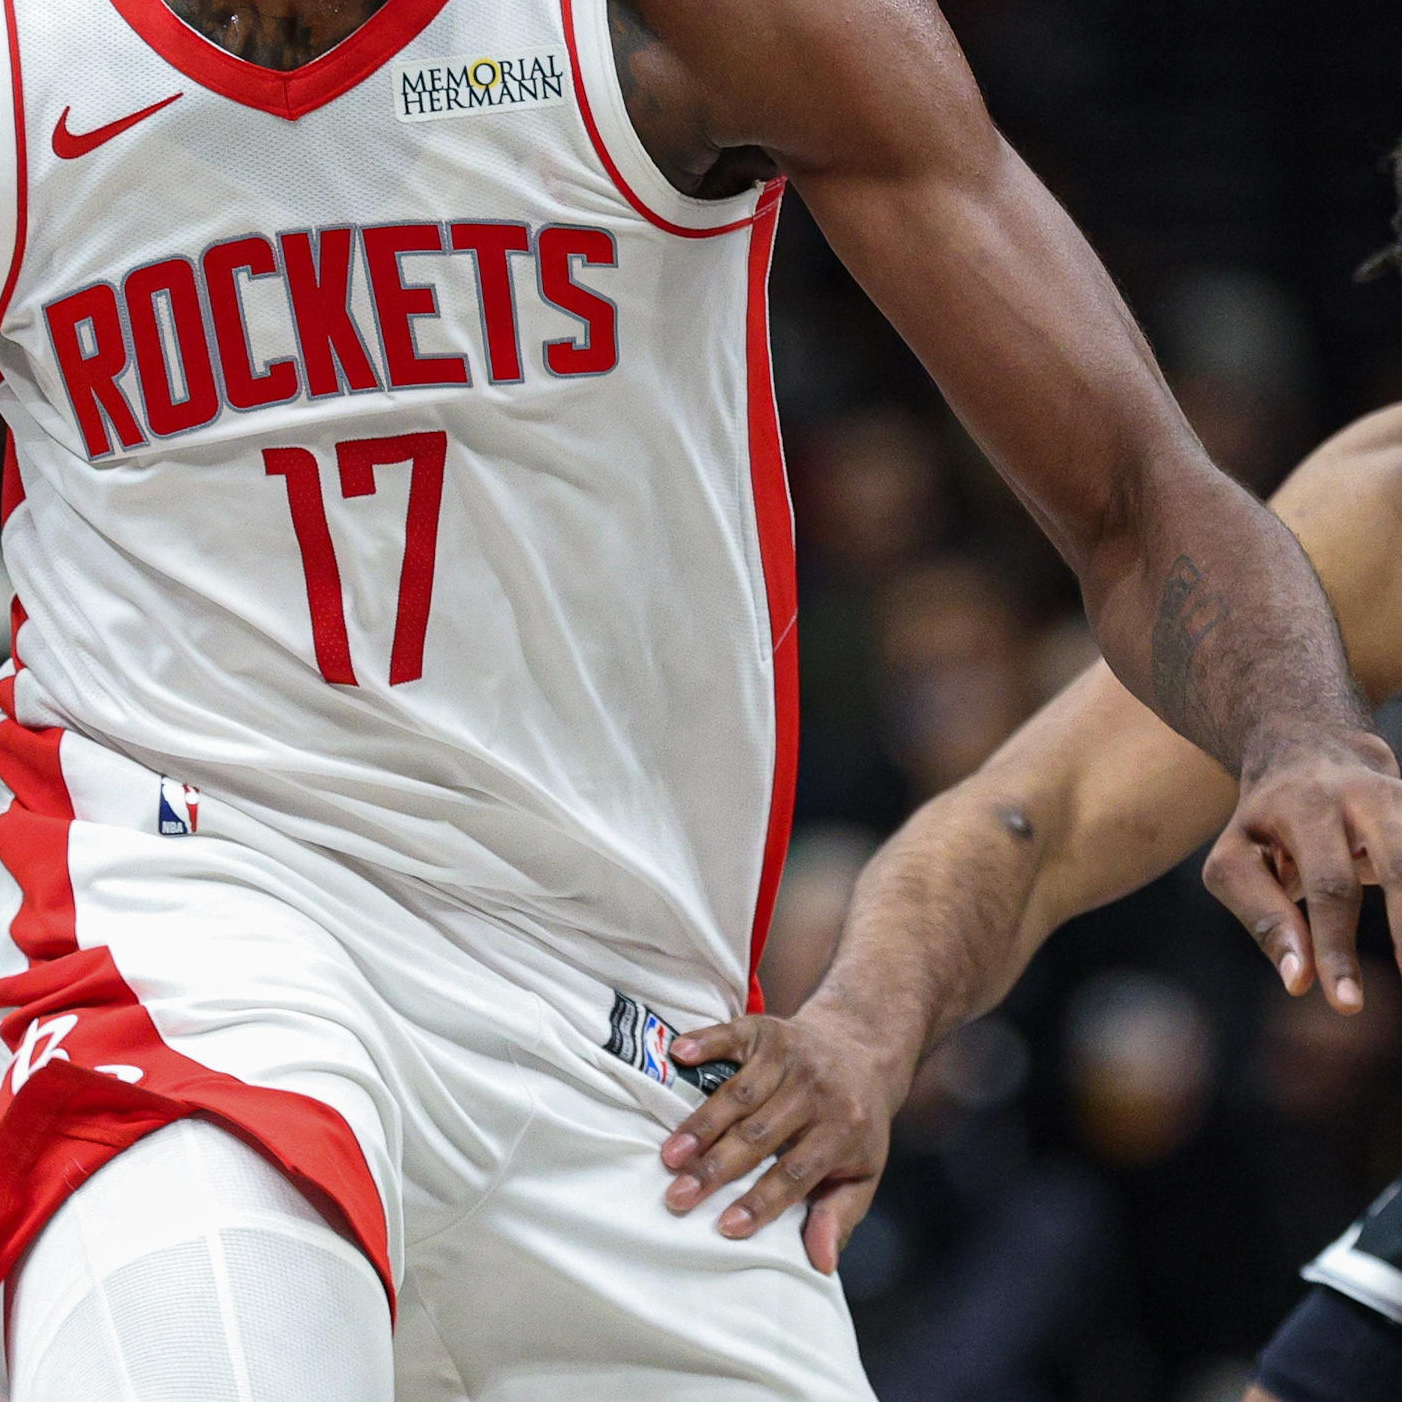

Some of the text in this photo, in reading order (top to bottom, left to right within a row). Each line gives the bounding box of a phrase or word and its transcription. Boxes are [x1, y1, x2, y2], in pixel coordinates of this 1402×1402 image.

[401, 54, 564, 96] MEMORIAL
[401, 75, 564, 116] HERMANN
[42, 219, 620, 462] ROCKETS
[261, 430, 448, 688] 17
